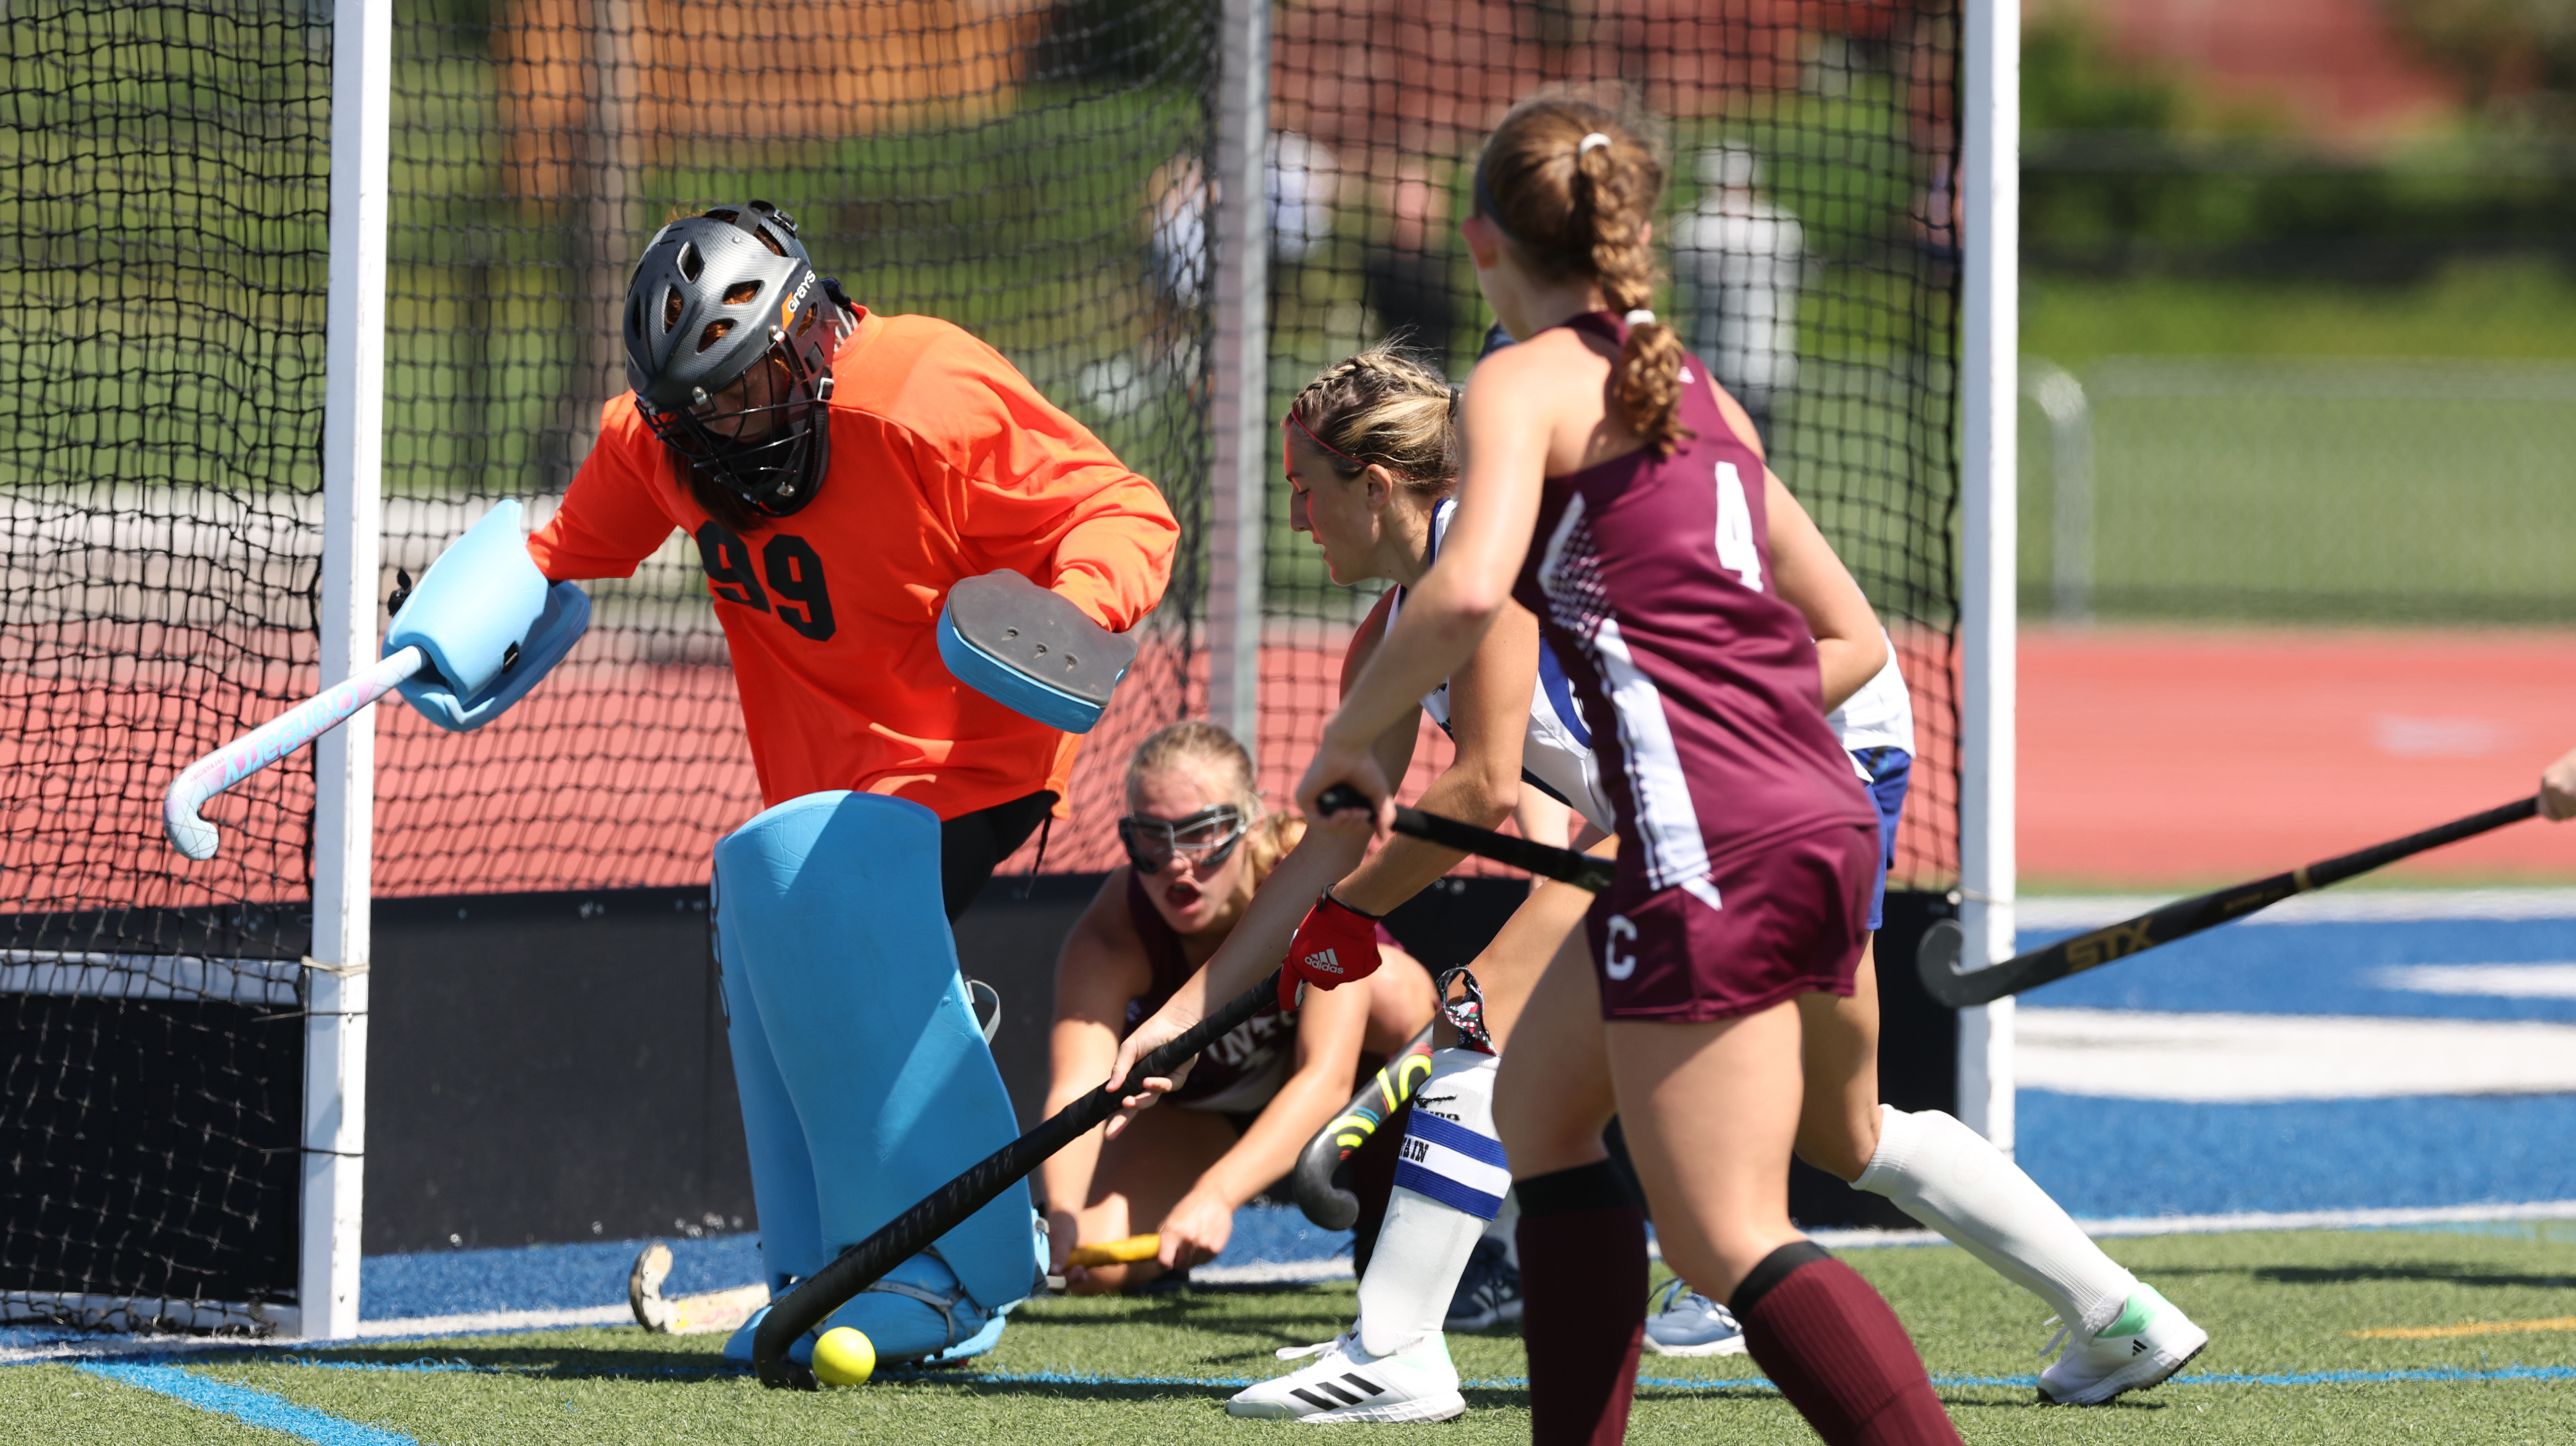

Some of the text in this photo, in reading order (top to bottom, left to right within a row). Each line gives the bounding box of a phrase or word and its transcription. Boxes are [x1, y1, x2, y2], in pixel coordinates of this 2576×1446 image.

[788, 270, 816, 313] Grays
[1714, 461, 1764, 592] 4
[695, 520, 836, 642] 99
[1304, 955, 1344, 975] adidas
[1604, 914, 1638, 981] C
[2066, 918, 2156, 973] STX
